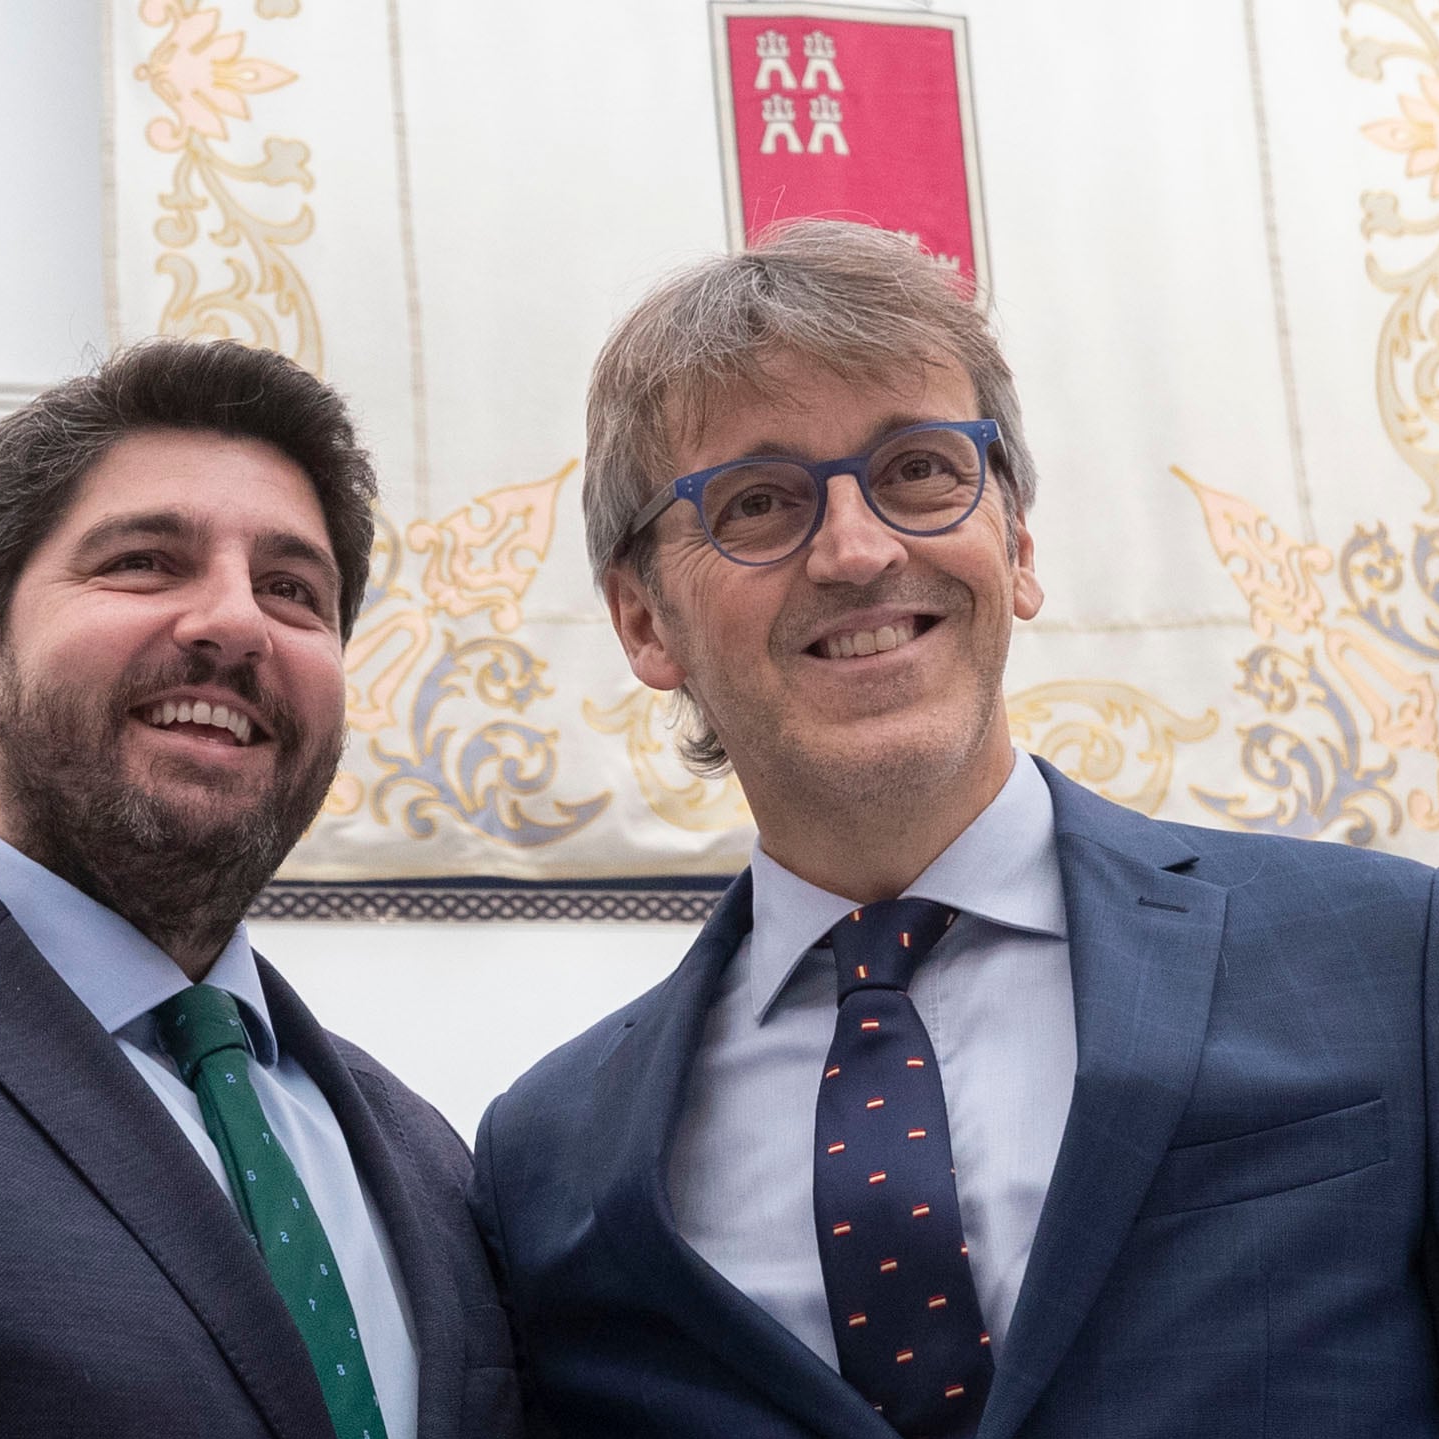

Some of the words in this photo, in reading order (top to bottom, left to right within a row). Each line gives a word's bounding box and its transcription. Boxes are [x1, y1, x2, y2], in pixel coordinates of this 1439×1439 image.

[225, 1072, 236, 1084] 2
[262, 1132, 270, 1145] 7
[246, 1169, 256, 1181] 5
[280, 1231, 290, 1243] 2
[348, 1327, 358, 1340] 2
